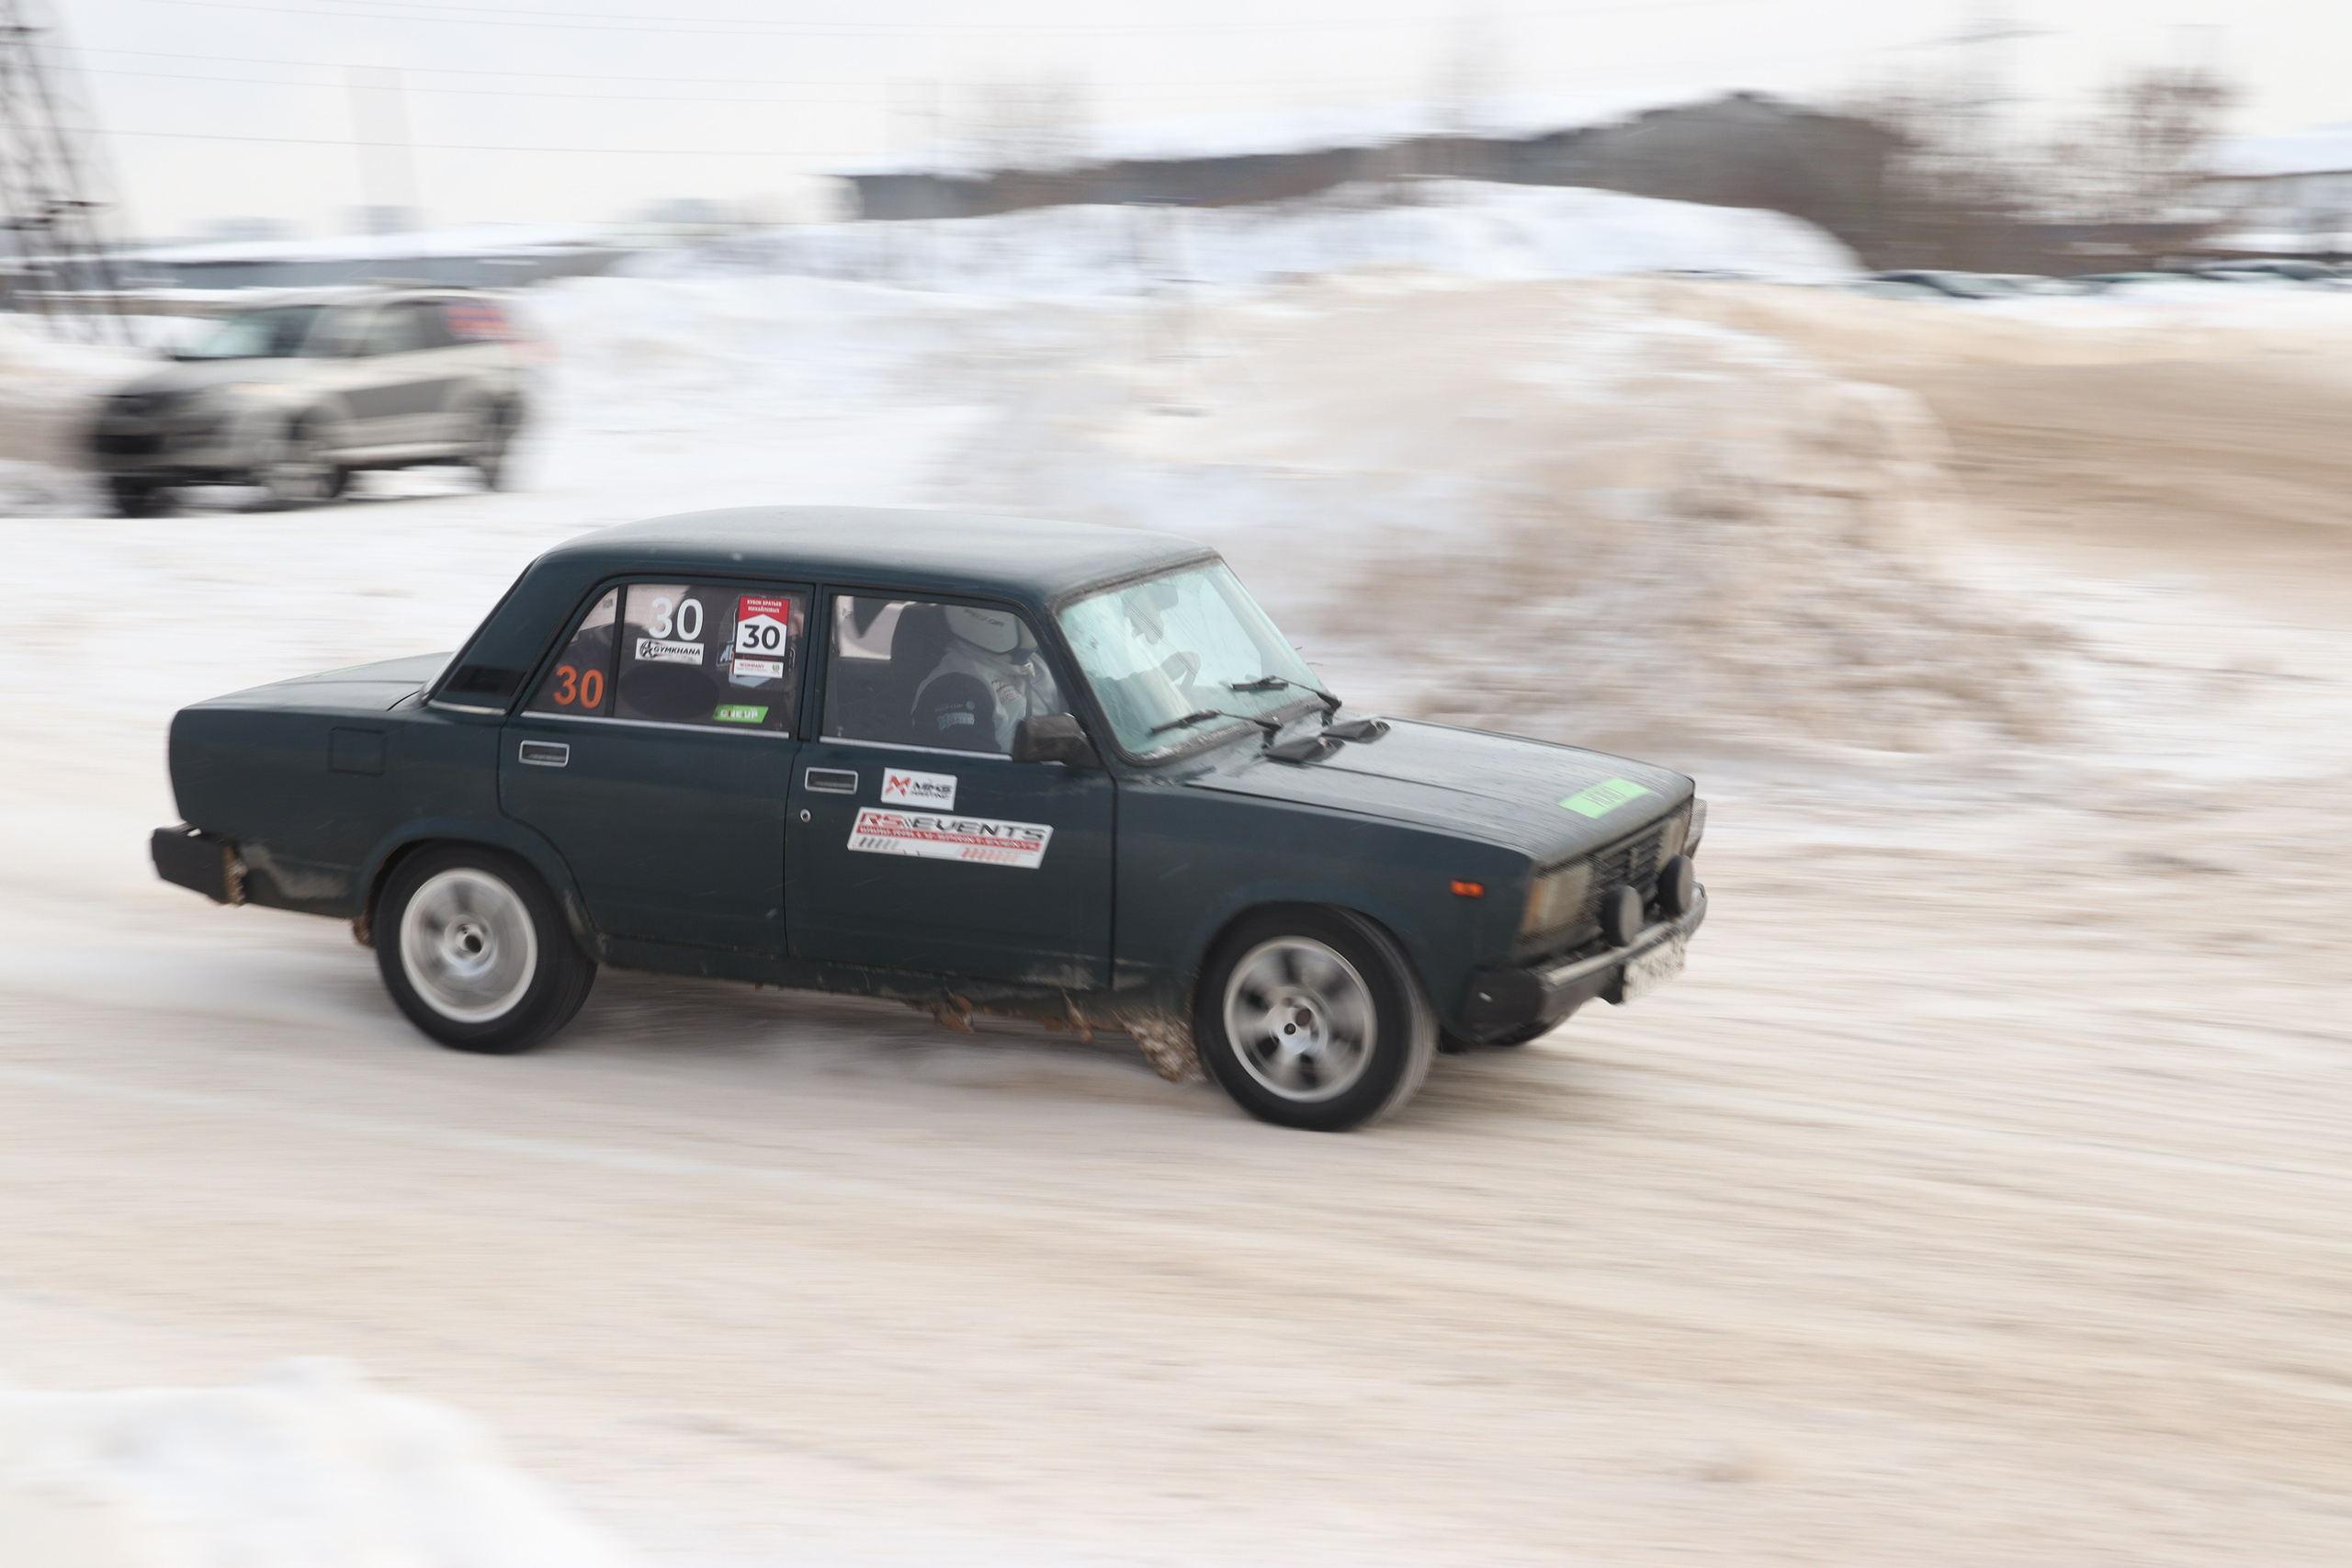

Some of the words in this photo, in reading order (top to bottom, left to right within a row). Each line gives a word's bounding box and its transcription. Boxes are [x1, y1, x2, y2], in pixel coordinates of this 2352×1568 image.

[649, 597, 703, 640] 30
[748, 605, 780, 614] МИХАЙЛОВЫХ
[742, 624, 780, 649] 30
[654, 645, 701, 656] GYMKHANA
[553, 665, 604, 708] 30
[912, 818, 1046, 840] EVENTS
